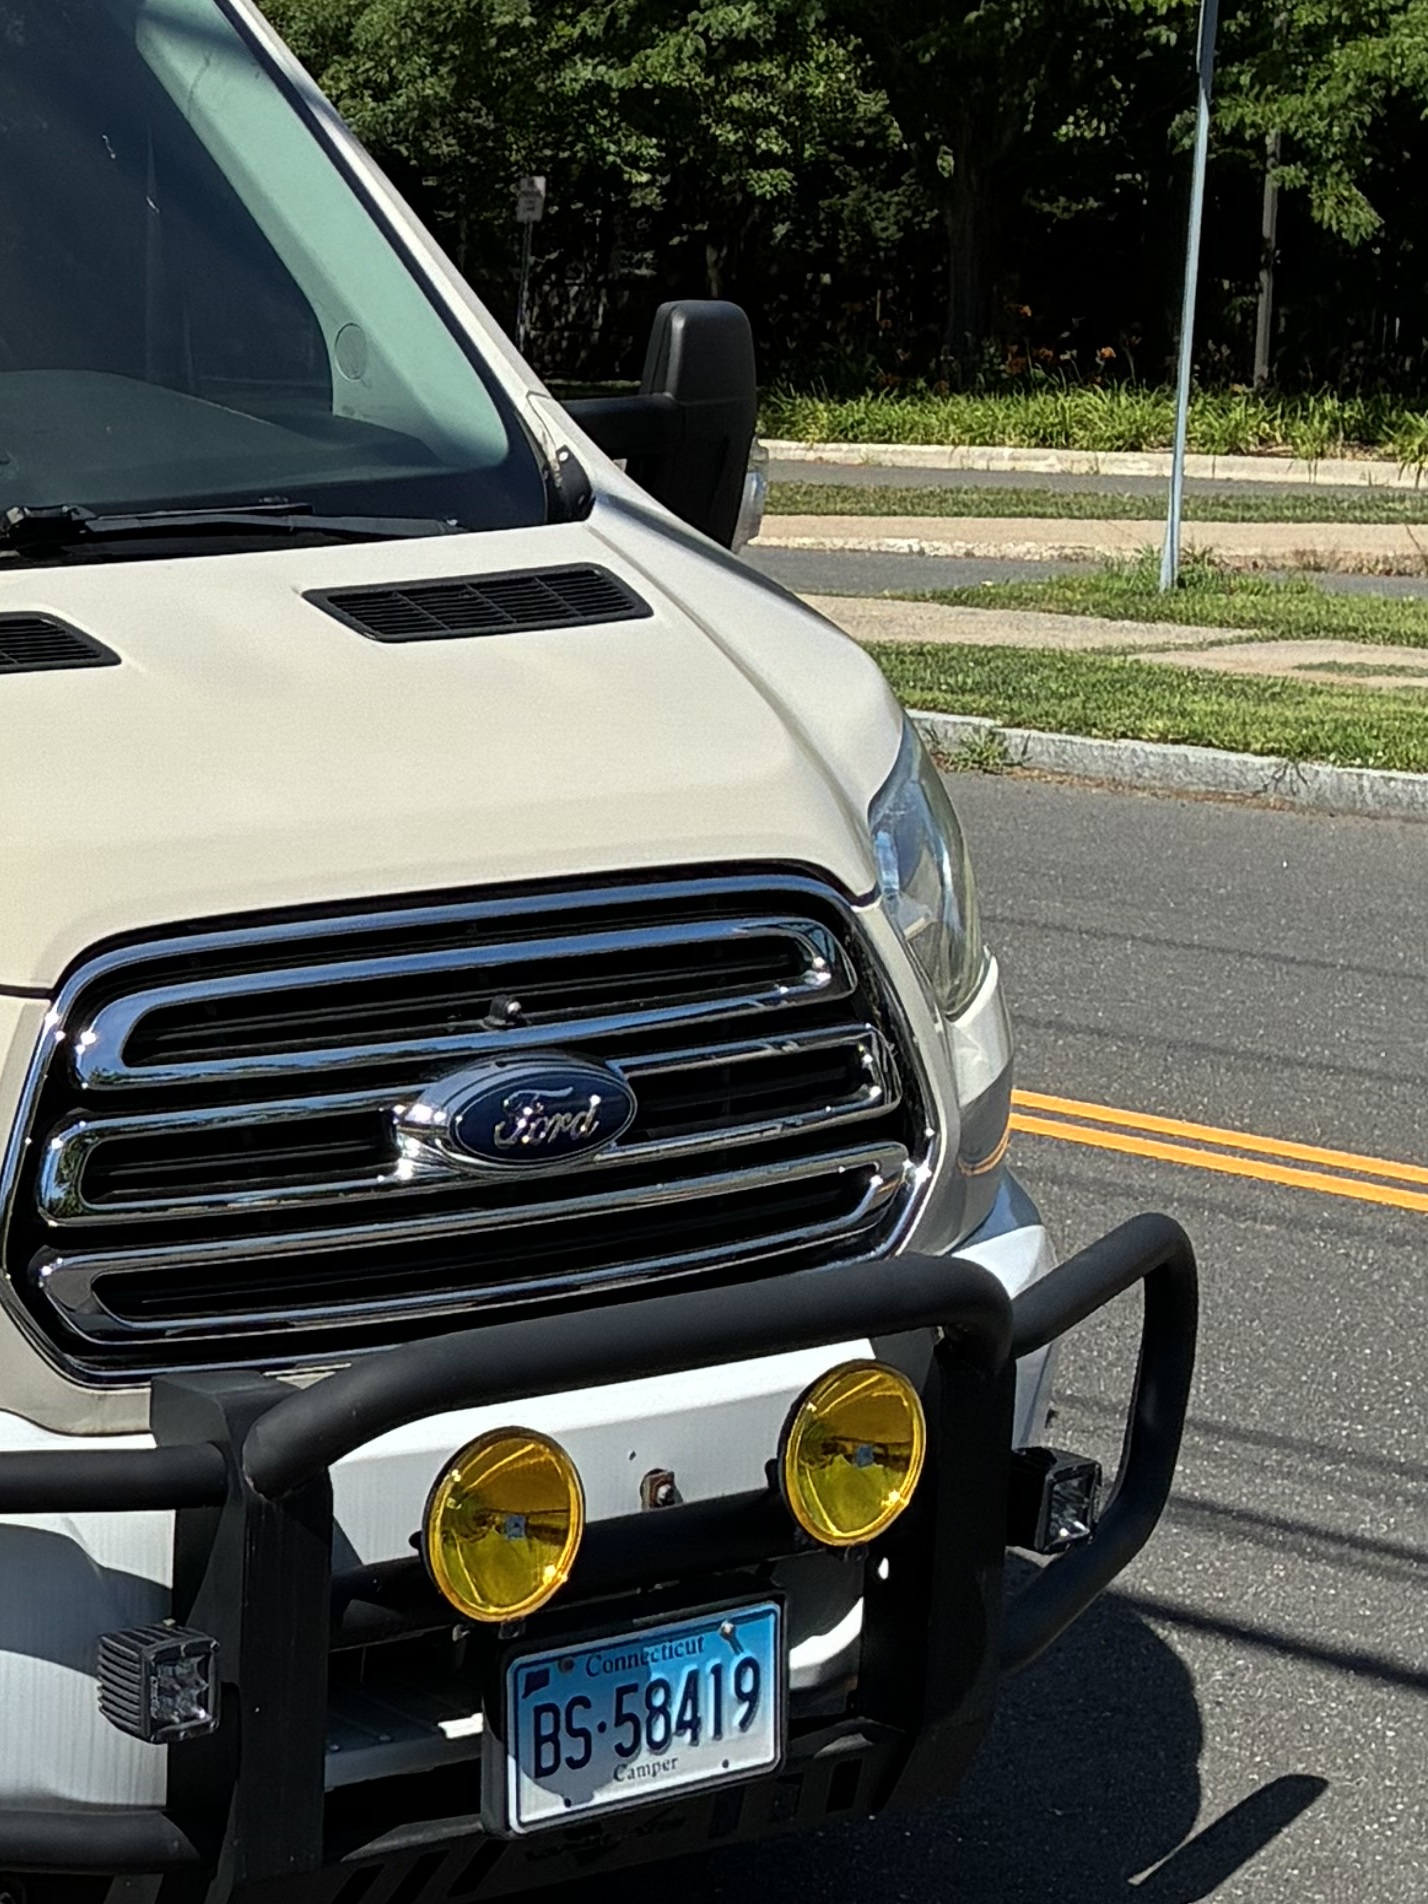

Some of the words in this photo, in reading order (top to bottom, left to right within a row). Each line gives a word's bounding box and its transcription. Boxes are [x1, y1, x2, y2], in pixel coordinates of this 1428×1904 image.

[494, 1086, 600, 1149] Ford
[585, 1636, 705, 1678] Connecticut
[613, 1754, 679, 1783] Camper
